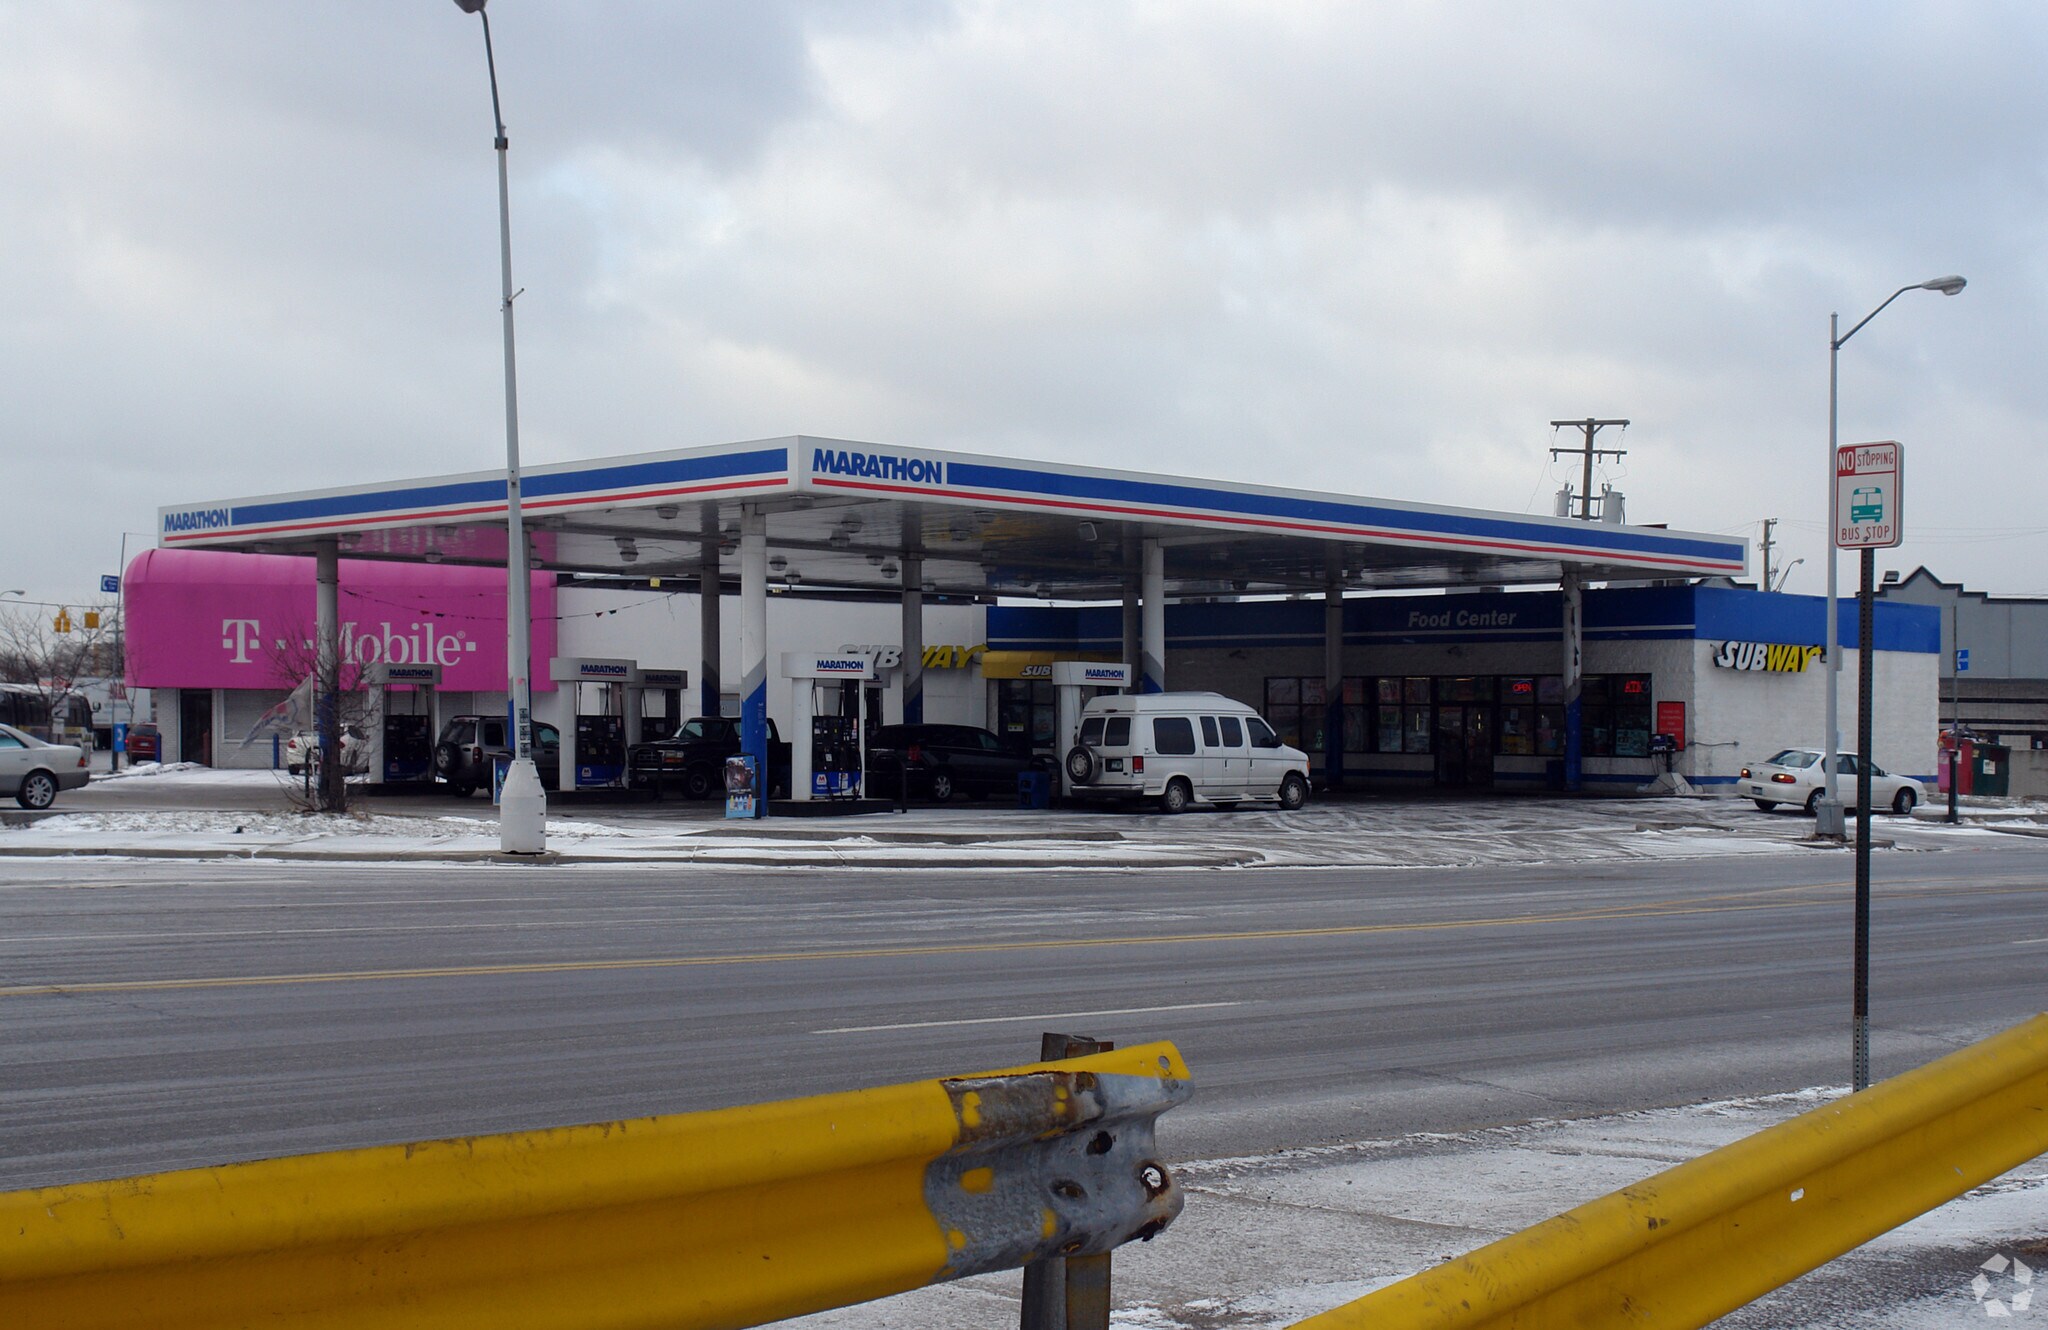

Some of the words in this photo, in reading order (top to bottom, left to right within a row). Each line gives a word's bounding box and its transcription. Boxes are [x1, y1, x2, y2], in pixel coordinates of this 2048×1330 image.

[812, 448, 942, 484] MARATHON
[1838, 451, 1854, 471] NO
[1857, 451, 1894, 467] STOPPING
[164, 508, 229, 532] MARATHON
[1841, 527, 1860, 541] BUS
[1866, 525, 1890, 540] STOP
[1408, 611, 1451, 627] Food
[1456, 610, 1517, 626] Center
[1717, 641, 1822, 672] SUBWAY
[388, 669, 433, 677] MARATHON
[581, 664, 627, 674] MARATHON
[816, 660, 864, 670] MARATHON
[1085, 669, 1124, 678] MARATHON
[1512, 683, 1533, 692] OPEN
